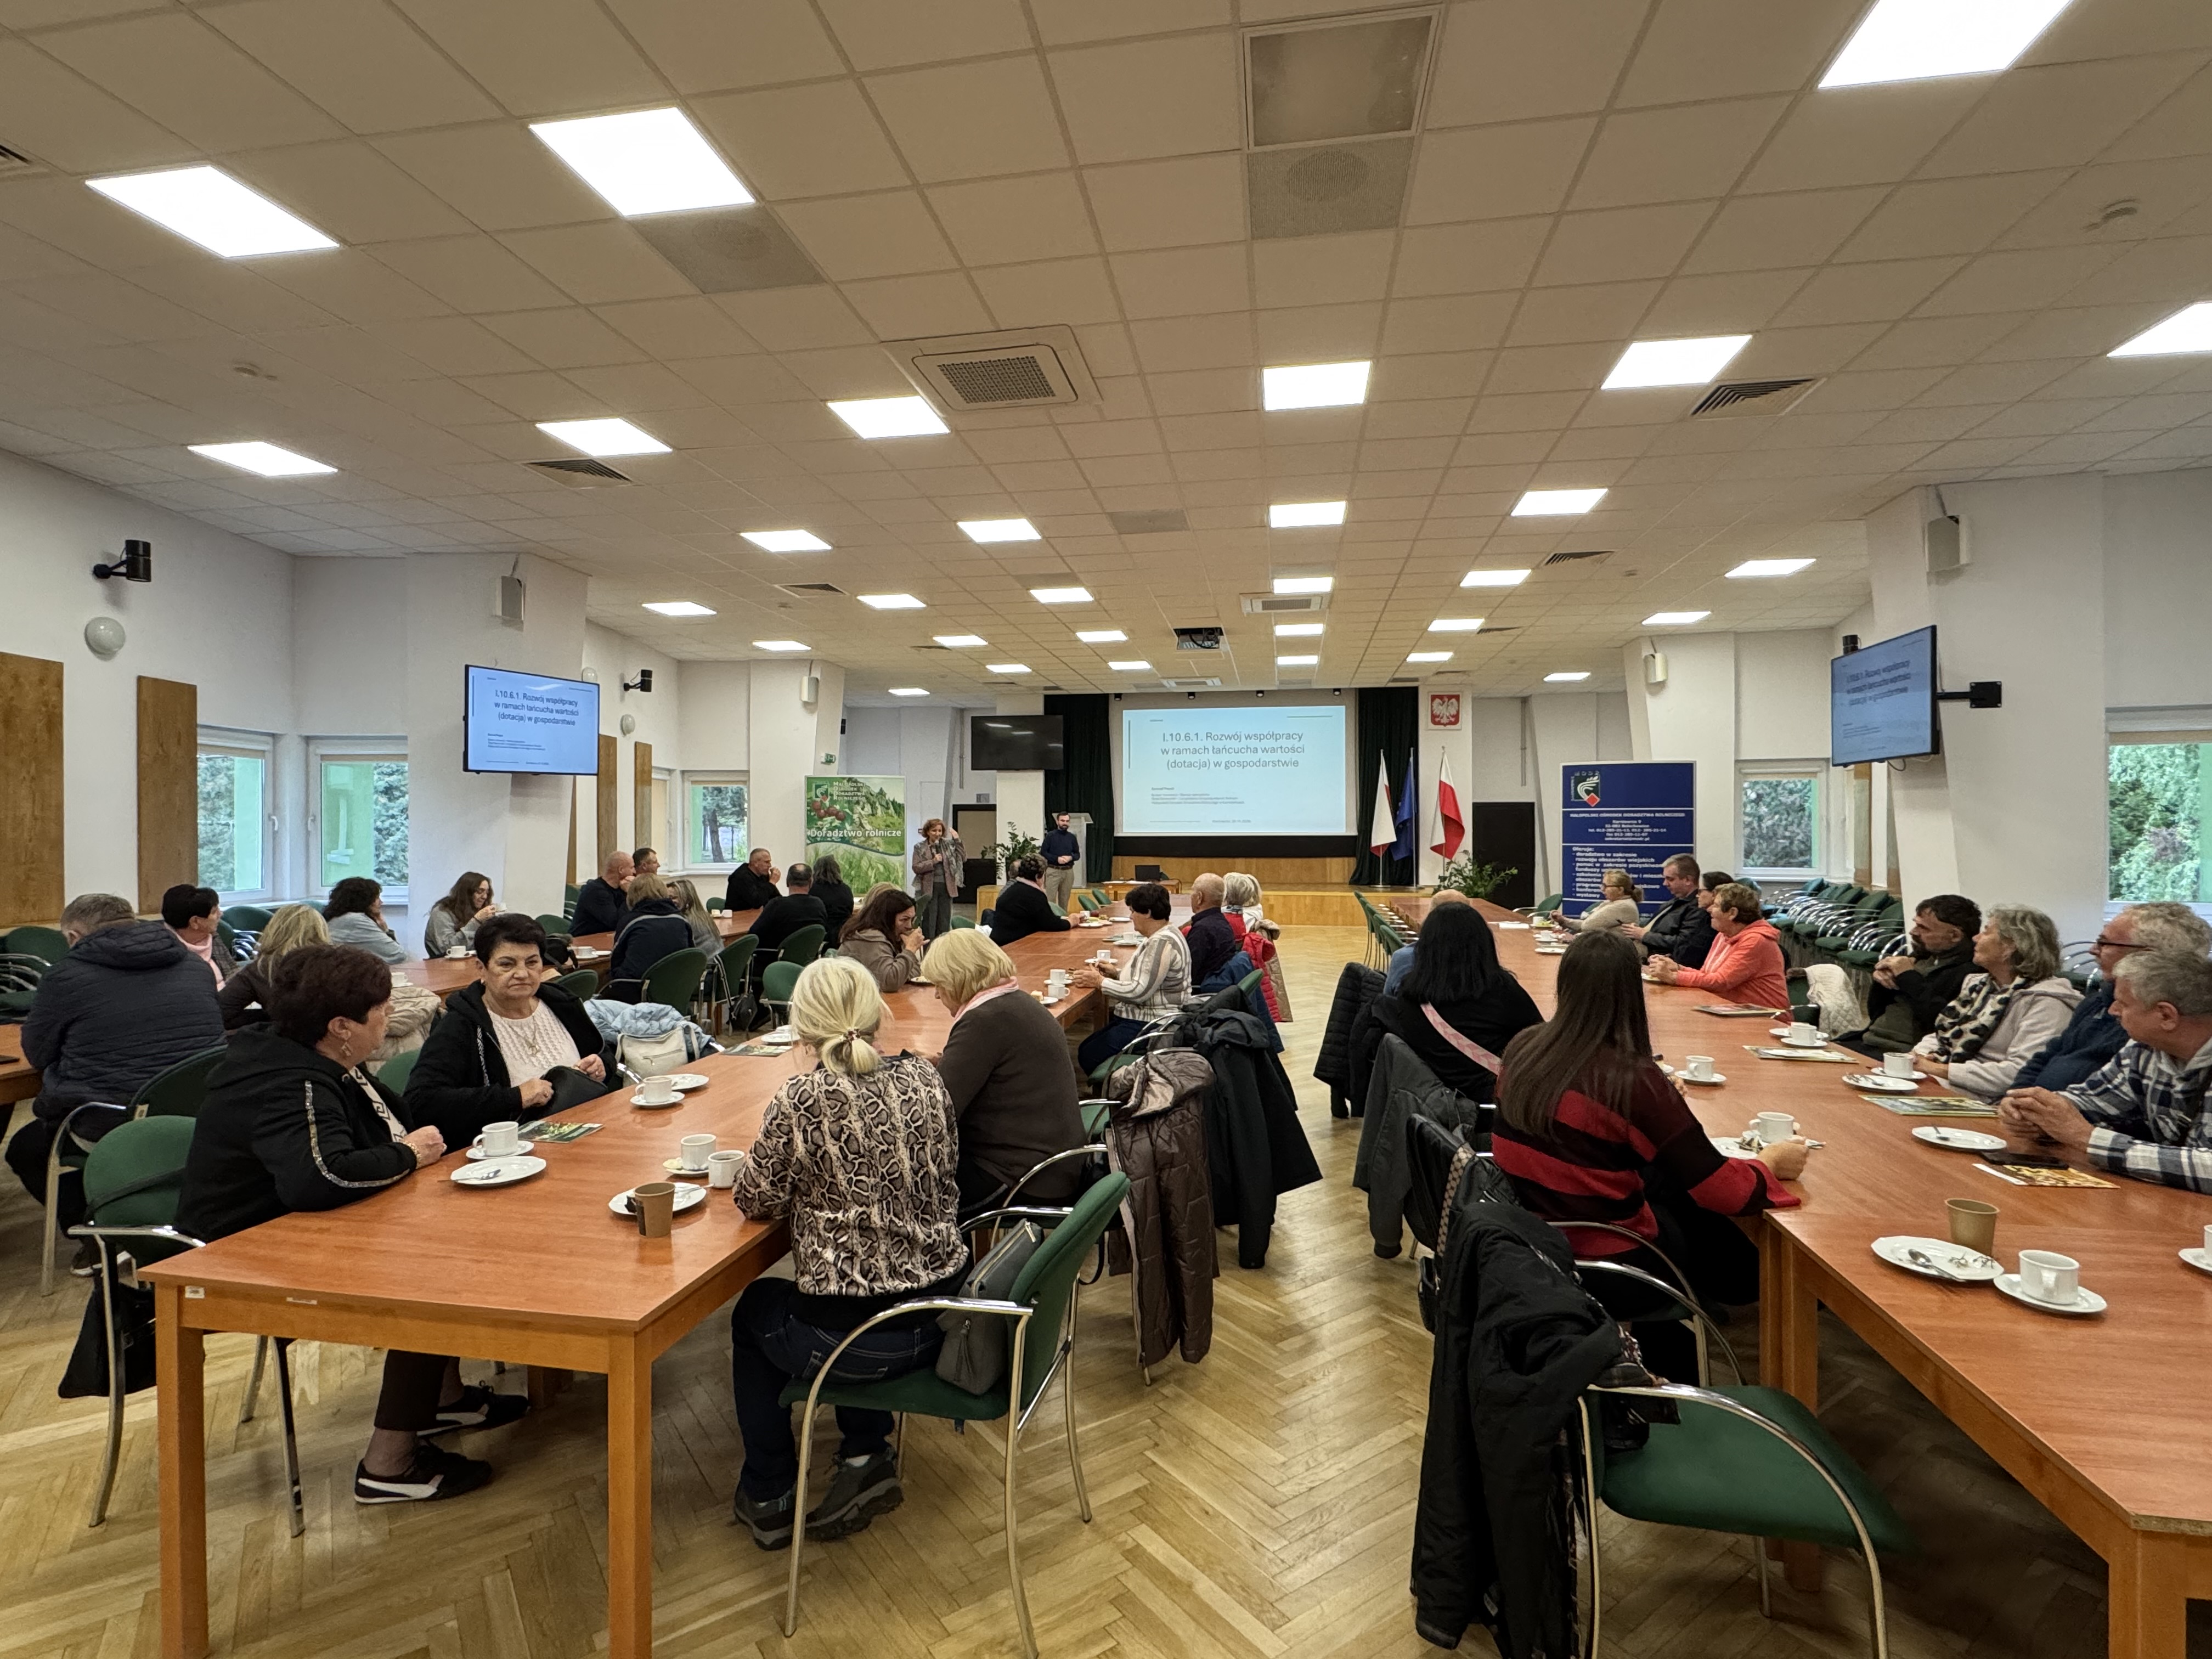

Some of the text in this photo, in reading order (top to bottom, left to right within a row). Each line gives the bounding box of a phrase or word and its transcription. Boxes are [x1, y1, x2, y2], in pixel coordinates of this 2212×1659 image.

[522, 692, 545, 704] Rozwój
[545, 697, 578, 708] współpracy
[501, 702, 526, 711] ramach
[498, 712, 526, 723] (dotacja)
[533, 716, 576, 726] gospodarstwie
[1206, 732, 1242, 743] Rozwój
[1244, 731, 1304, 742] współpracy
[1172, 746, 1209, 755] ramach
[1212, 744, 1259, 755] łańcucha
[1260, 744, 1305, 754] wartości
[1167, 759, 1211, 770] (dotacja)
[1224, 758, 1299, 770] gospodarstwie
[811, 829, 902, 837] Doradztwo rolnicze
